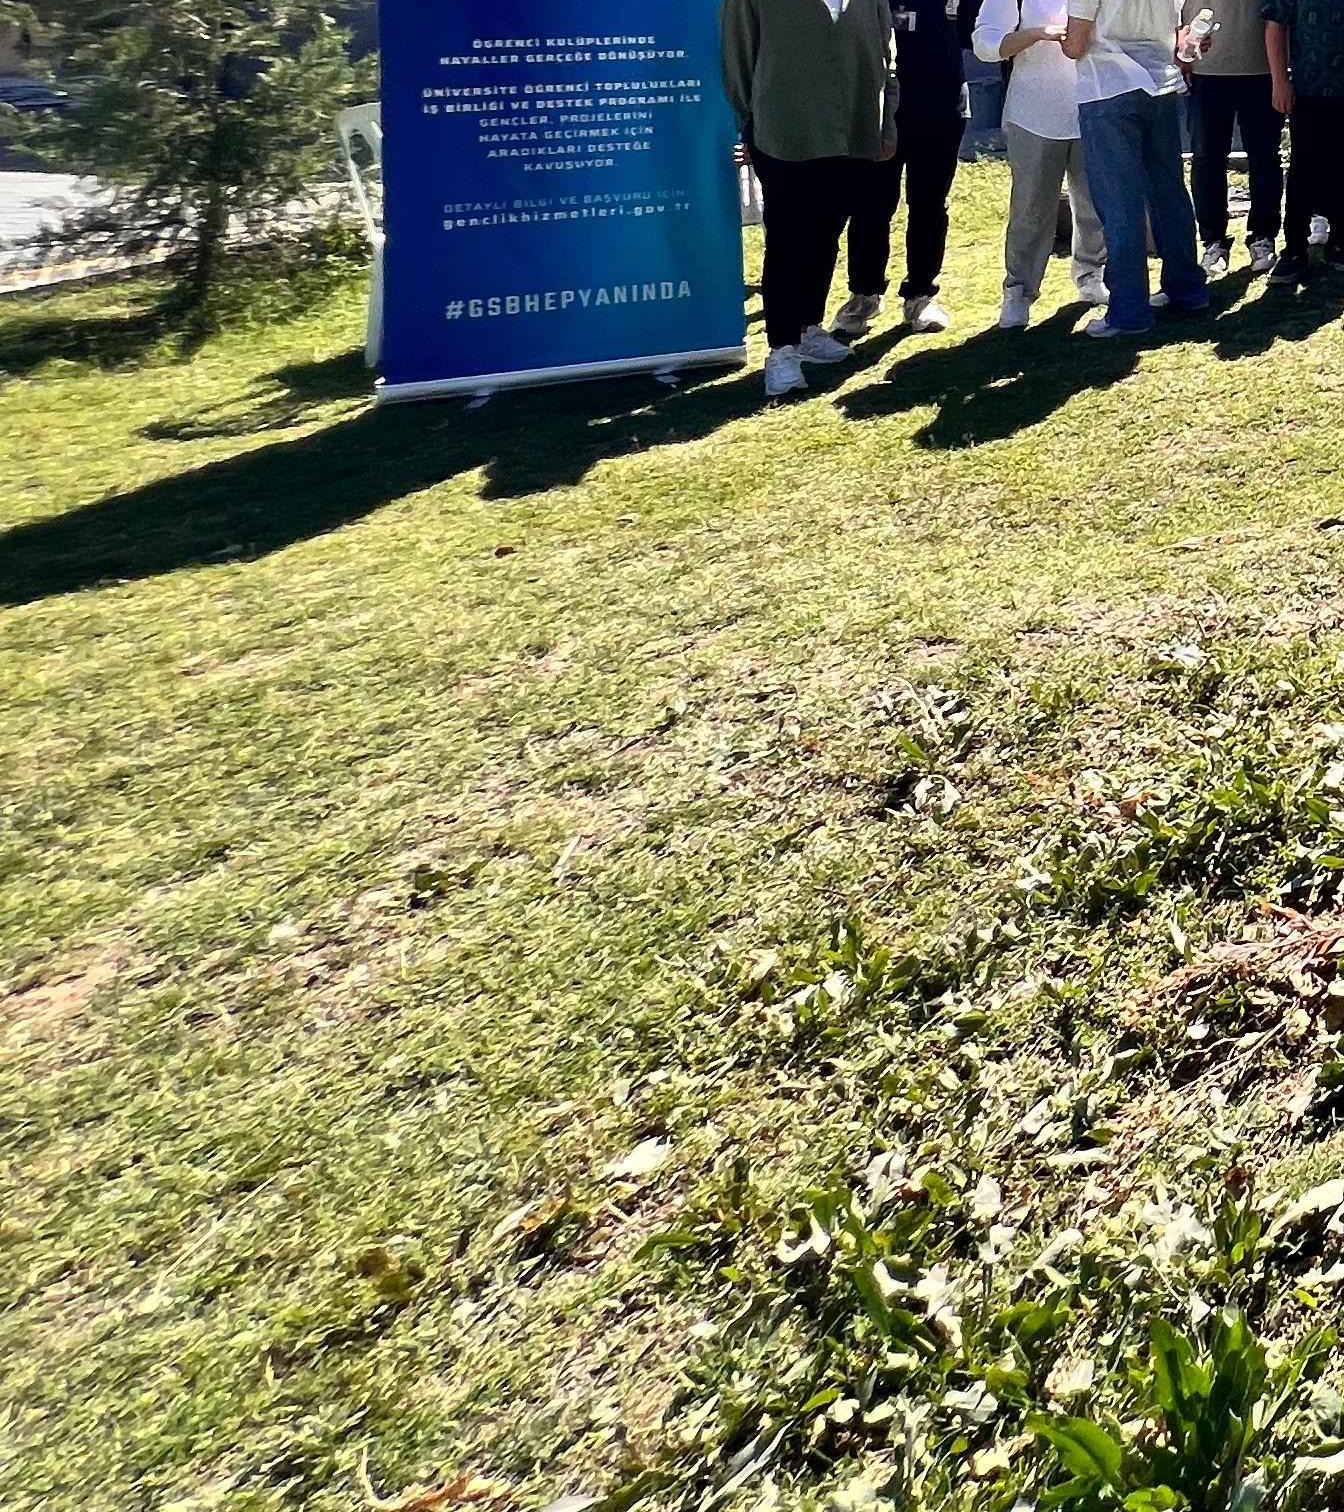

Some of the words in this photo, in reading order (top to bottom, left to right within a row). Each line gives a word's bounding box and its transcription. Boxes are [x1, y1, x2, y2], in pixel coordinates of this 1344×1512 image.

[472, 37, 540, 49] ÖĞRENCİ
[546, 35, 656, 47] KULÜPLERİNDE
[439, 54, 519, 65] HAYALLER
[526, 52, 592, 63] GERÇEĞE
[422, 85, 518, 98] ÜNİVERSİTE
[524, 82, 589, 94] ÖĞRENCİ
[511, 100, 529, 110] VE
[536, 97, 593, 109] DESTEK
[599, 94, 675, 106] PROGRAMI
[679, 93, 702, 103] İLE
[479, 131, 538, 143] HAYATA
[544, 127, 619, 140] GEÇİRMEK
[624, 125, 654, 137] İÇİN
[487, 144, 581, 158] ARADIKLARI
[587, 140, 651, 153] DESTEĞE
[443, 201, 507, 214] DETAYLI
[560, 195, 578, 205] VE
[583, 191, 651, 204] BAŞVURU
[443, 203, 691, 230] genclikhizmetleri.gov.tr
[445, 280, 692, 320] #GSBHEPYANINDA
